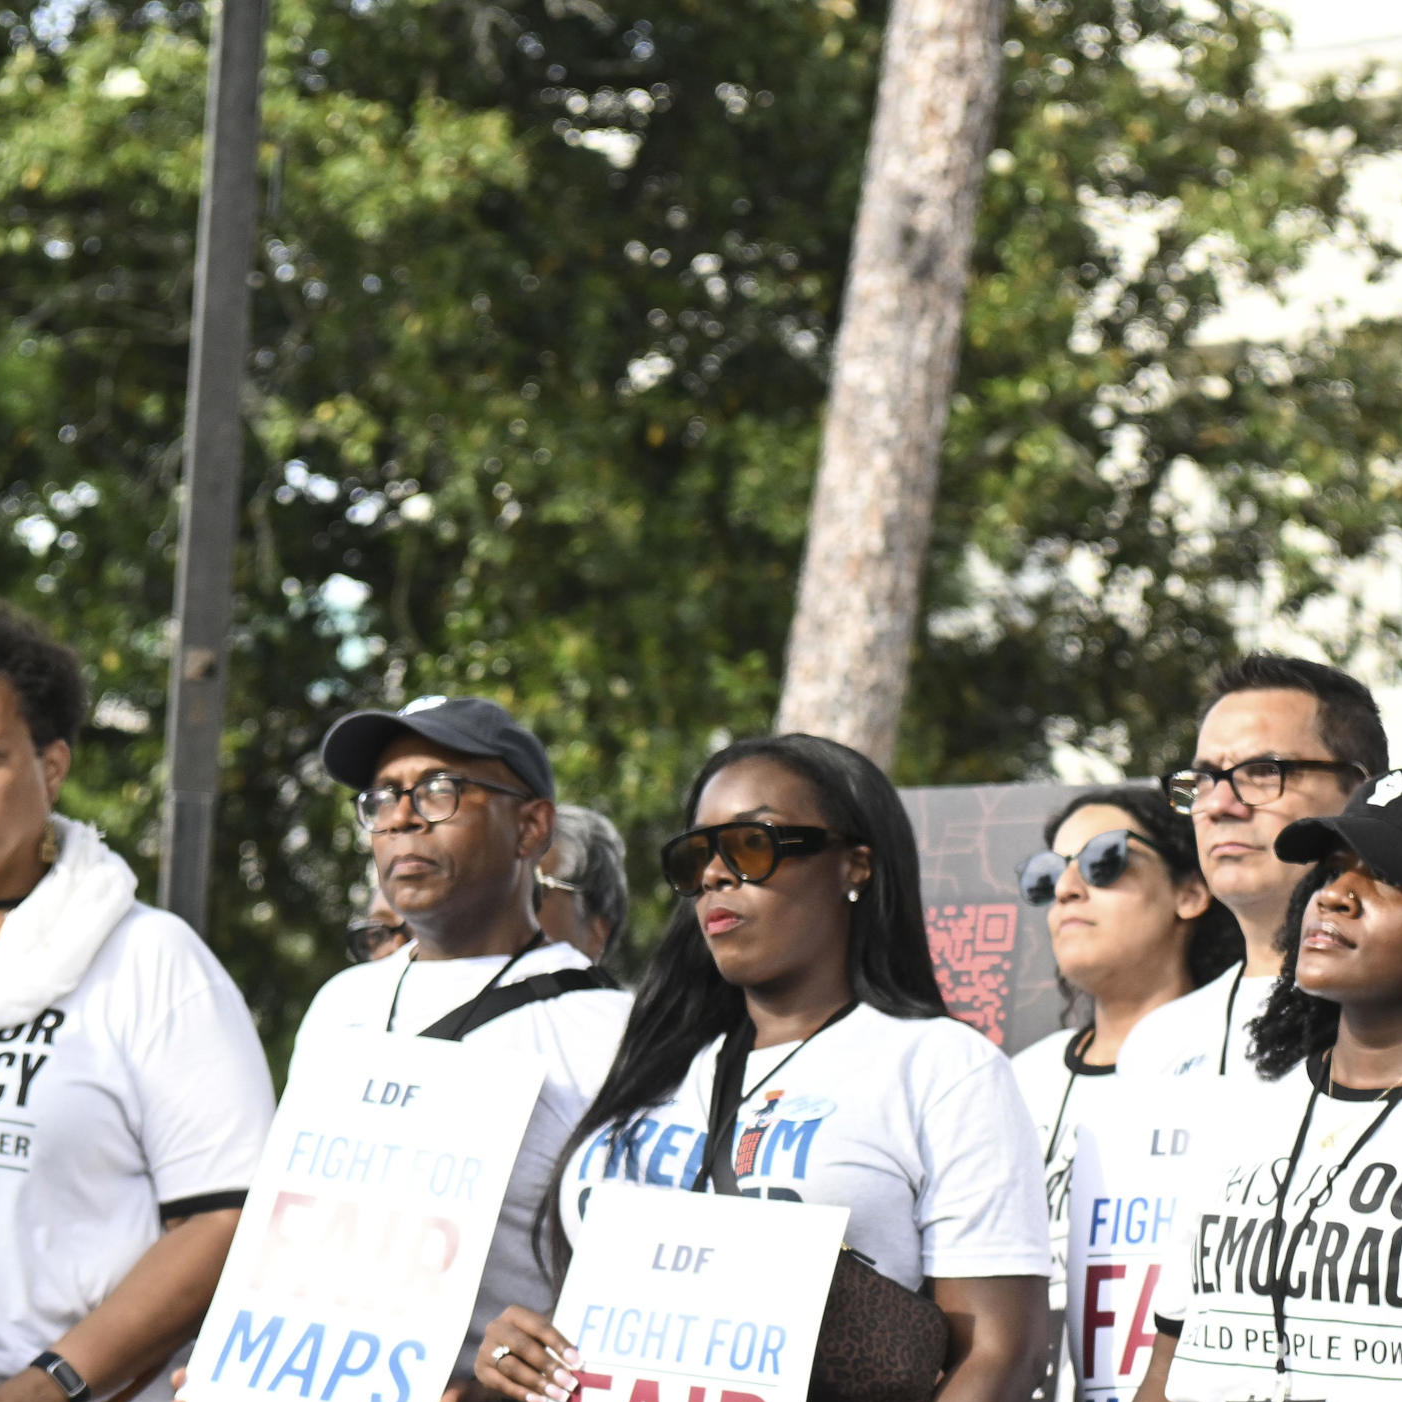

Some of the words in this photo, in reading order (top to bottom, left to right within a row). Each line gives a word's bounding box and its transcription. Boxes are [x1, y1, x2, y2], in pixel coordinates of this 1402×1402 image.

[362, 1079, 421, 1108] LDF
[1150, 1129, 1190, 1156] LD
[287, 1130, 396, 1184] FIGHT
[406, 1148, 483, 1201] FOR
[1224, 1157, 1293, 1206] HIS
[1088, 1197, 1177, 1247] FIGH
[652, 1243, 715, 1274] LDF
[574, 1305, 699, 1366] FIGHT
[705, 1321, 787, 1374] FOR
[1246, 1329, 1342, 1361] PEOPLE
